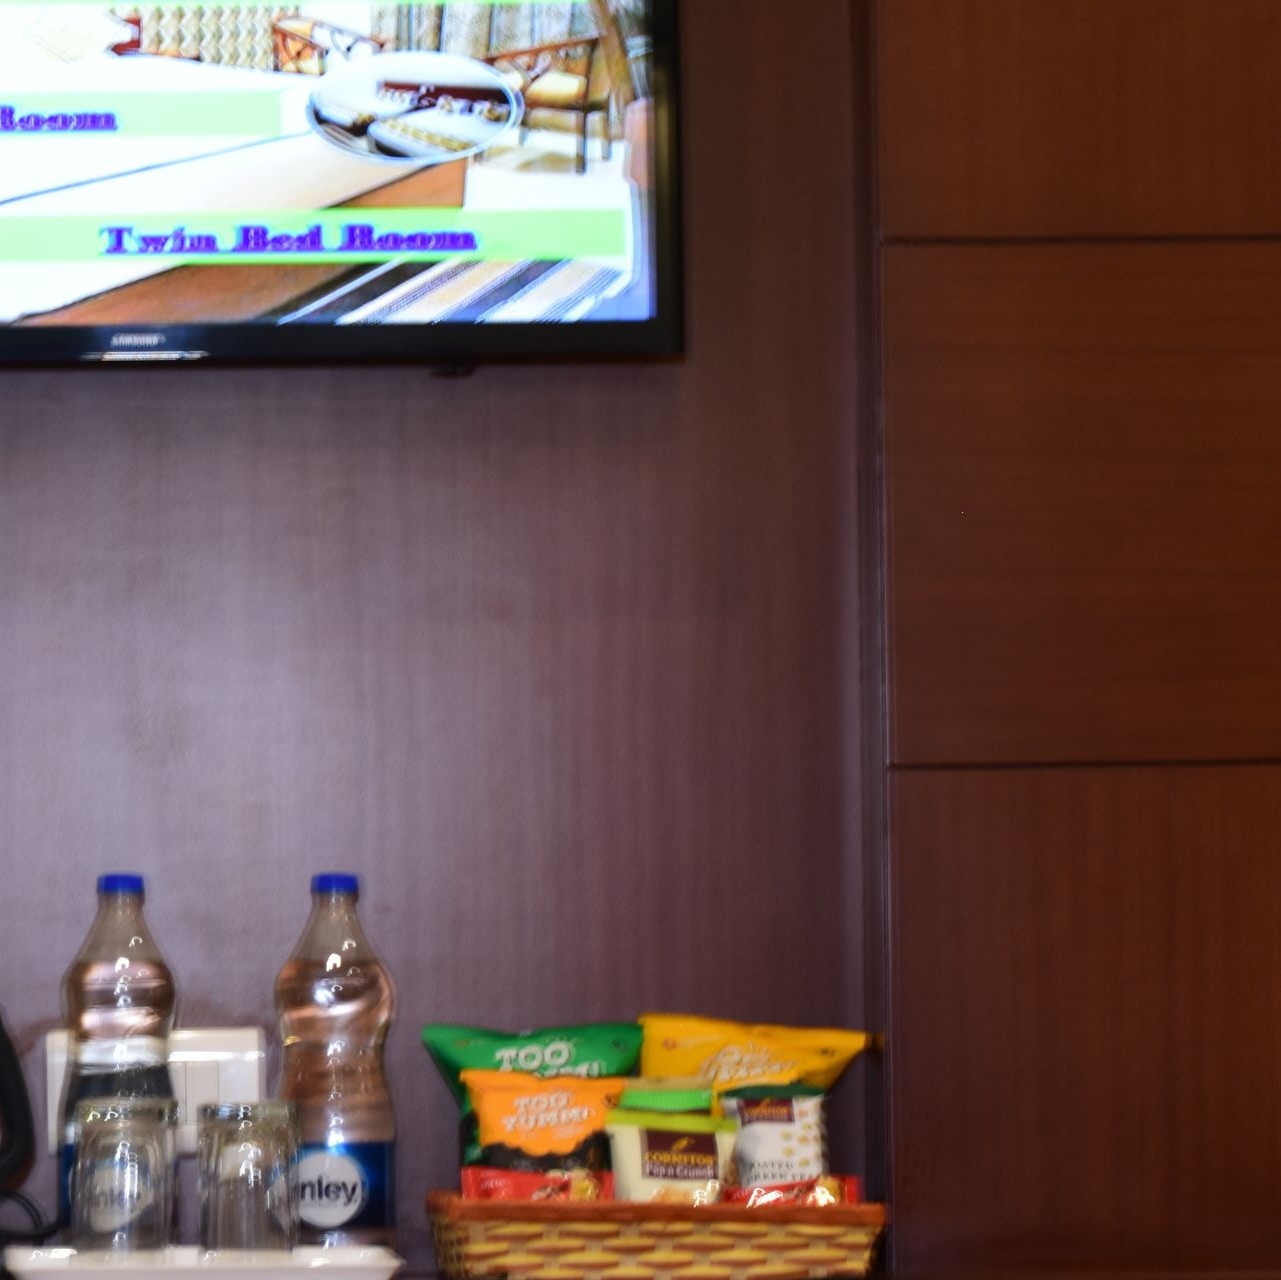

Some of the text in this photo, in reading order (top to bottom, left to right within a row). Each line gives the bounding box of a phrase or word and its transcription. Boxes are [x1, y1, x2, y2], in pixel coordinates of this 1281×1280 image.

[100, 224, 477, 254] Twin Bed Room
[495, 1040, 570, 1072] TOO
[514, 1093, 570, 1115] TOO
